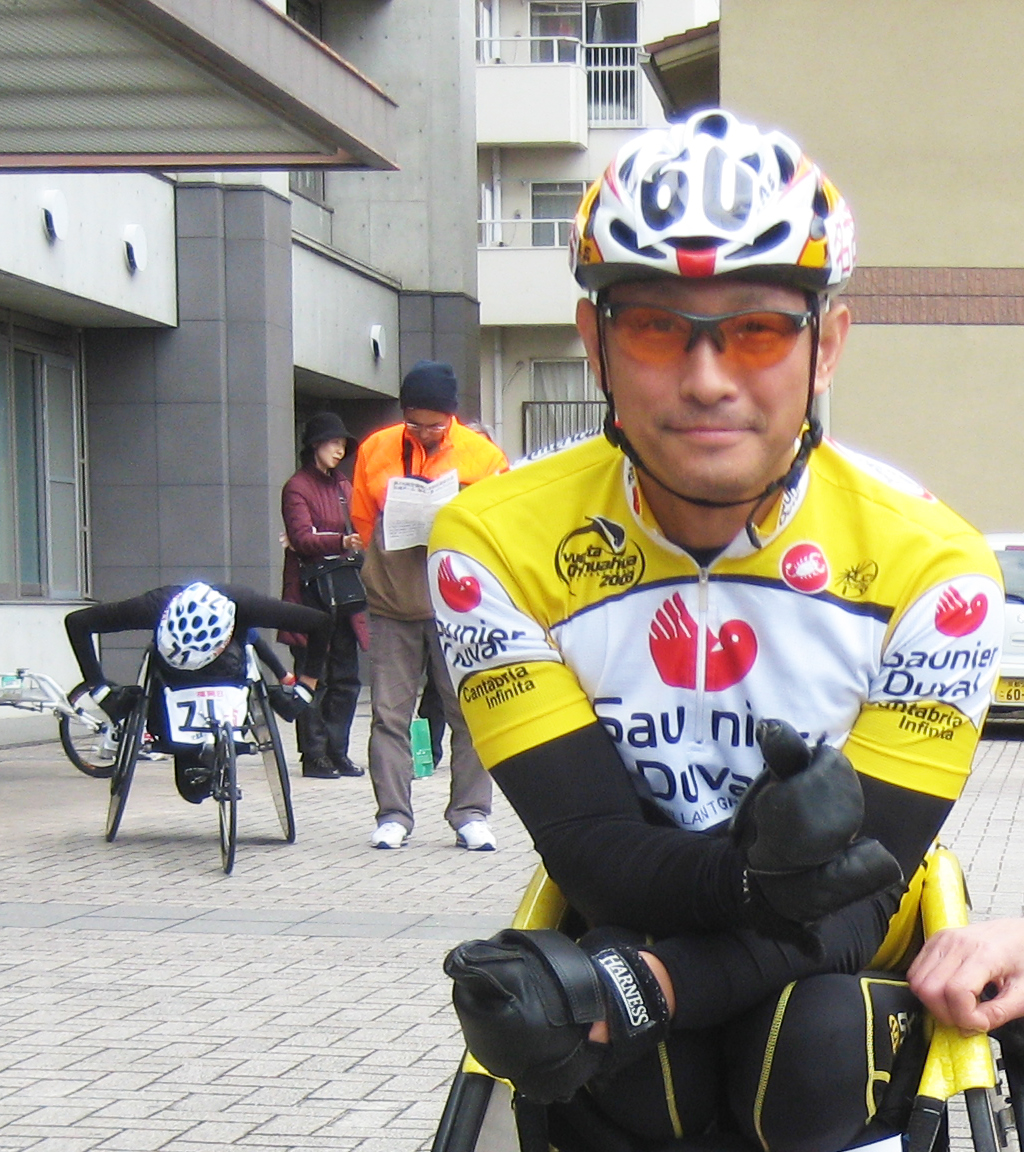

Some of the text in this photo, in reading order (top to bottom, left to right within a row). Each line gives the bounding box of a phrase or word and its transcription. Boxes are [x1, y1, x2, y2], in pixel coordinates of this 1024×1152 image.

[463, 665, 530, 703] Cantabria
[485, 679, 536, 710] Infinita
[882, 670, 981, 697] Duval
[593, 696, 810, 749] Sauni
[877, 701, 963, 728] ntabria
[635, 760, 755, 804] Duva
[599, 954, 649, 1027] HARNESS
